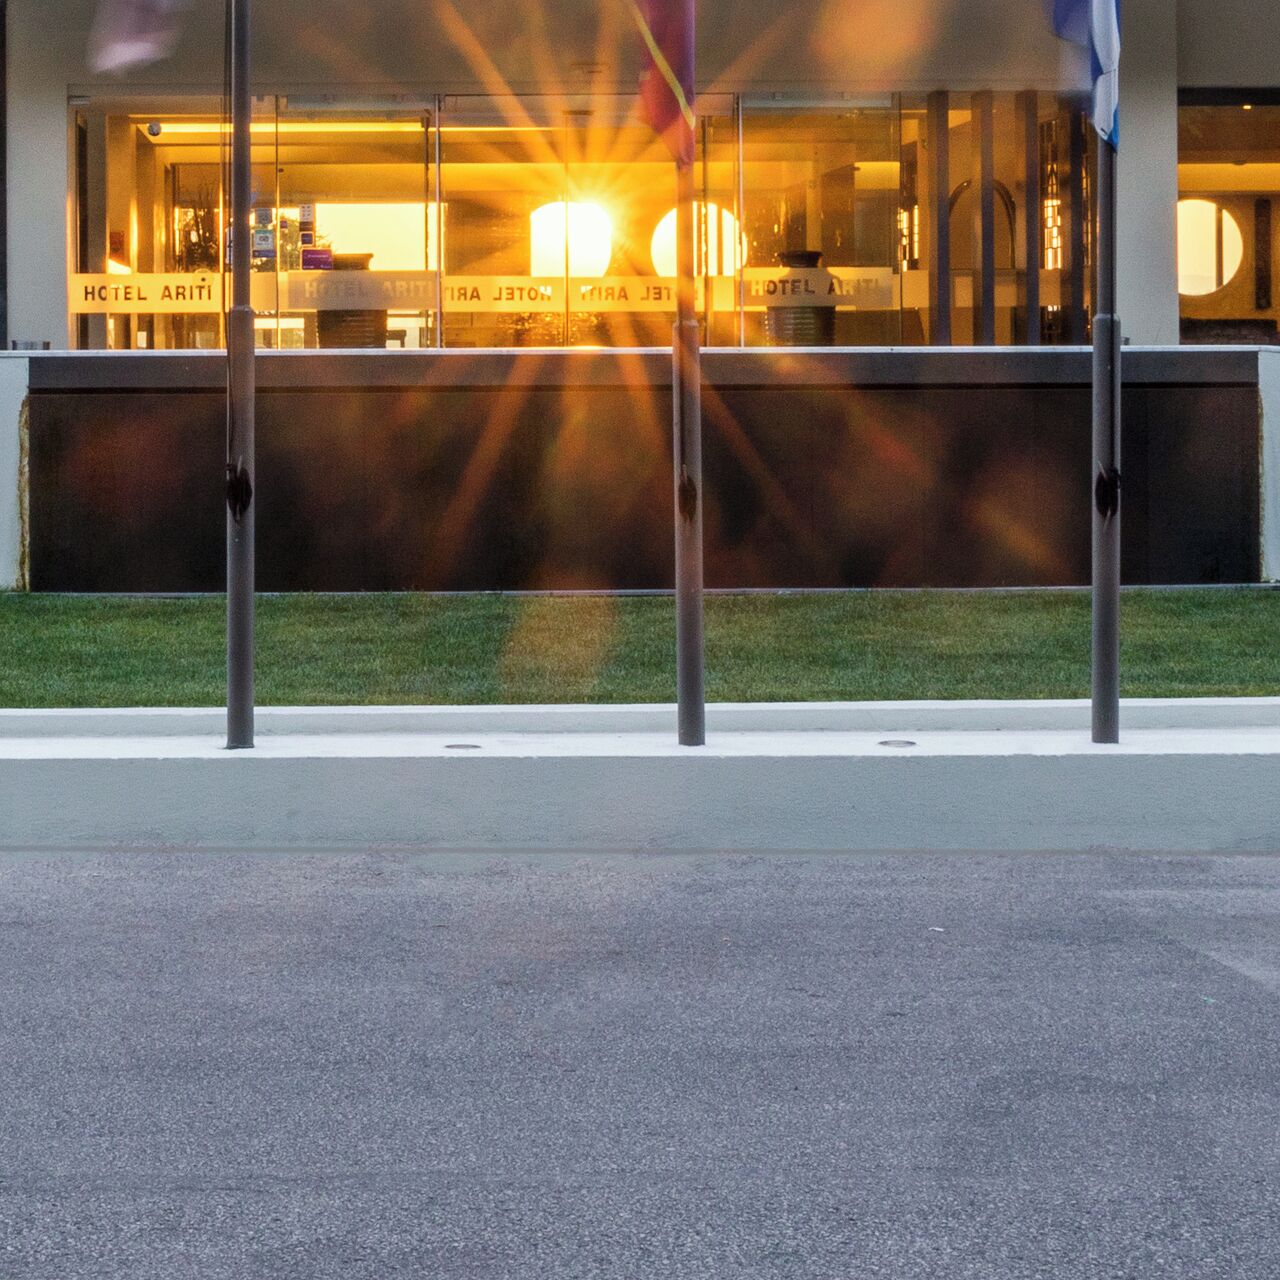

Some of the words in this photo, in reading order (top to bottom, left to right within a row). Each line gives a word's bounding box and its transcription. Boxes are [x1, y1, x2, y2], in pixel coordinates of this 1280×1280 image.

[83, 284, 148, 302] HOTEL
[160, 284, 213, 301] ARITI
[750, 278, 817, 297] HOTEL
